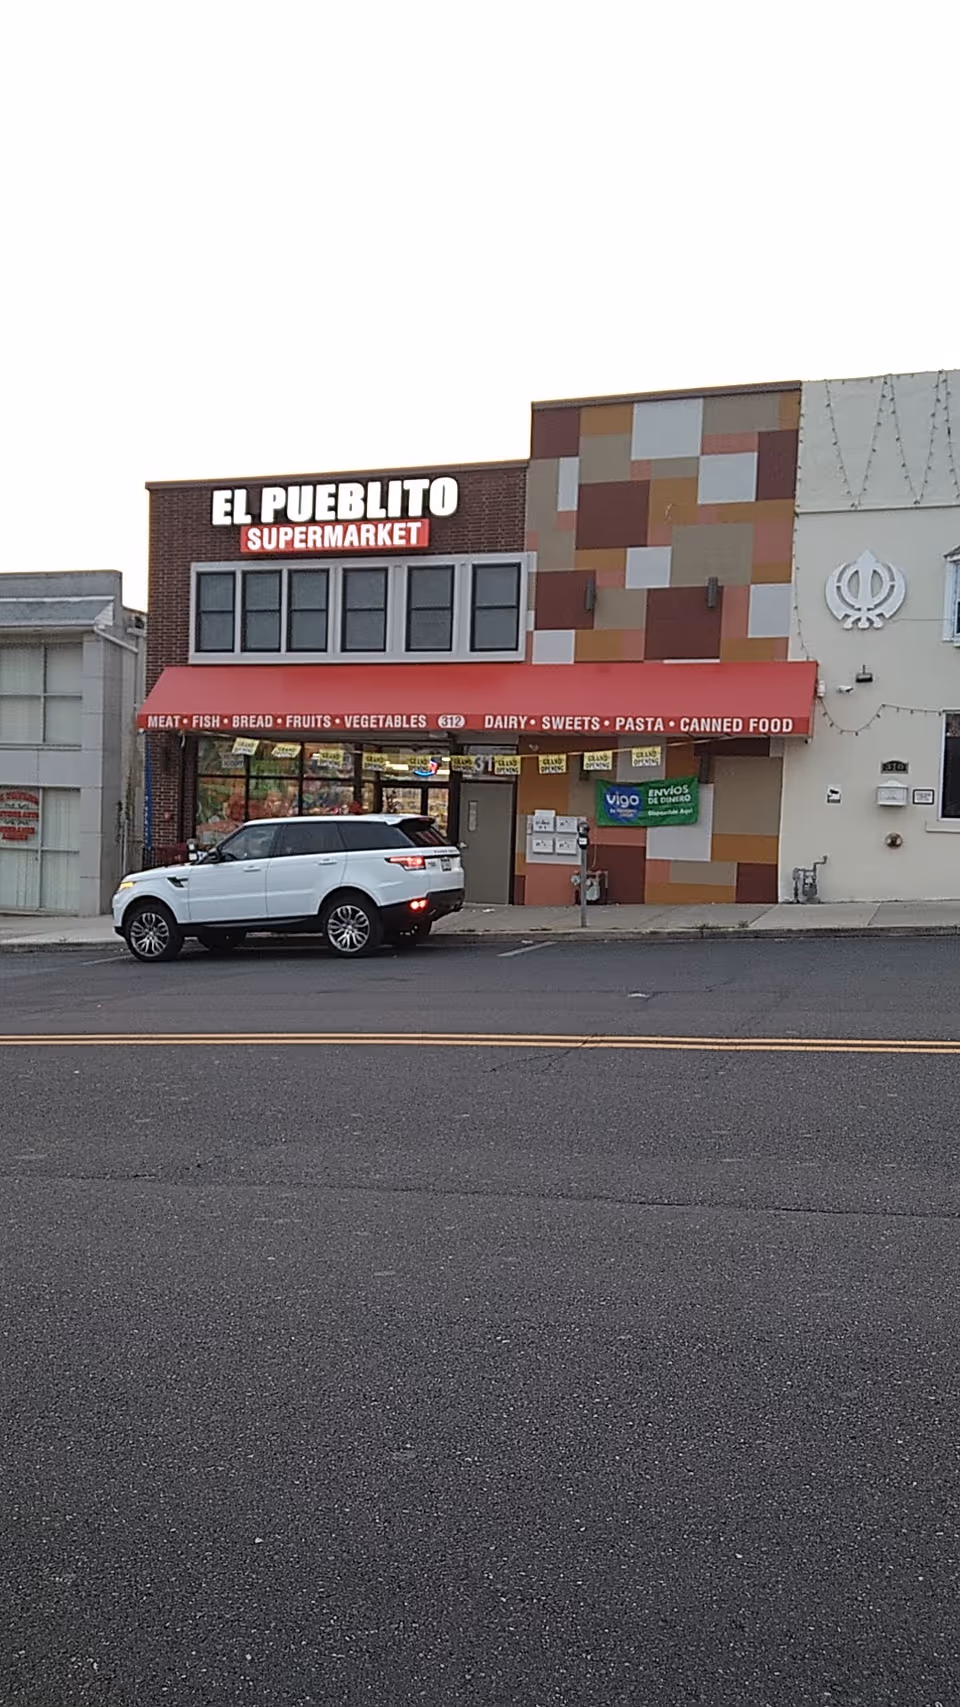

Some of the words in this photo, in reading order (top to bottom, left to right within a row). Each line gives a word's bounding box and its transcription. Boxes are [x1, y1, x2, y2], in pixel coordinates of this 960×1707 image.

[212, 488, 252, 526] EL
[261, 477, 459, 523] PUEBLITO
[247, 522, 422, 550] SUPERMARKET
[148, 715, 181, 728] MEAT
[192, 715, 220, 728] FISH
[232, 715, 273, 728] BREAD
[286, 715, 331, 728] FRUITS
[344, 715, 427, 728] VEGETABLES
[440, 715, 462, 727] 312
[485, 715, 527, 729] DAIRY
[542, 716, 600, 730] SWEETS
[615, 717, 664, 731] PASTA
[680, 717, 743, 732] CANNED
[750, 718, 793, 732] FOOD
[606, 791, 639, 808] vigo
